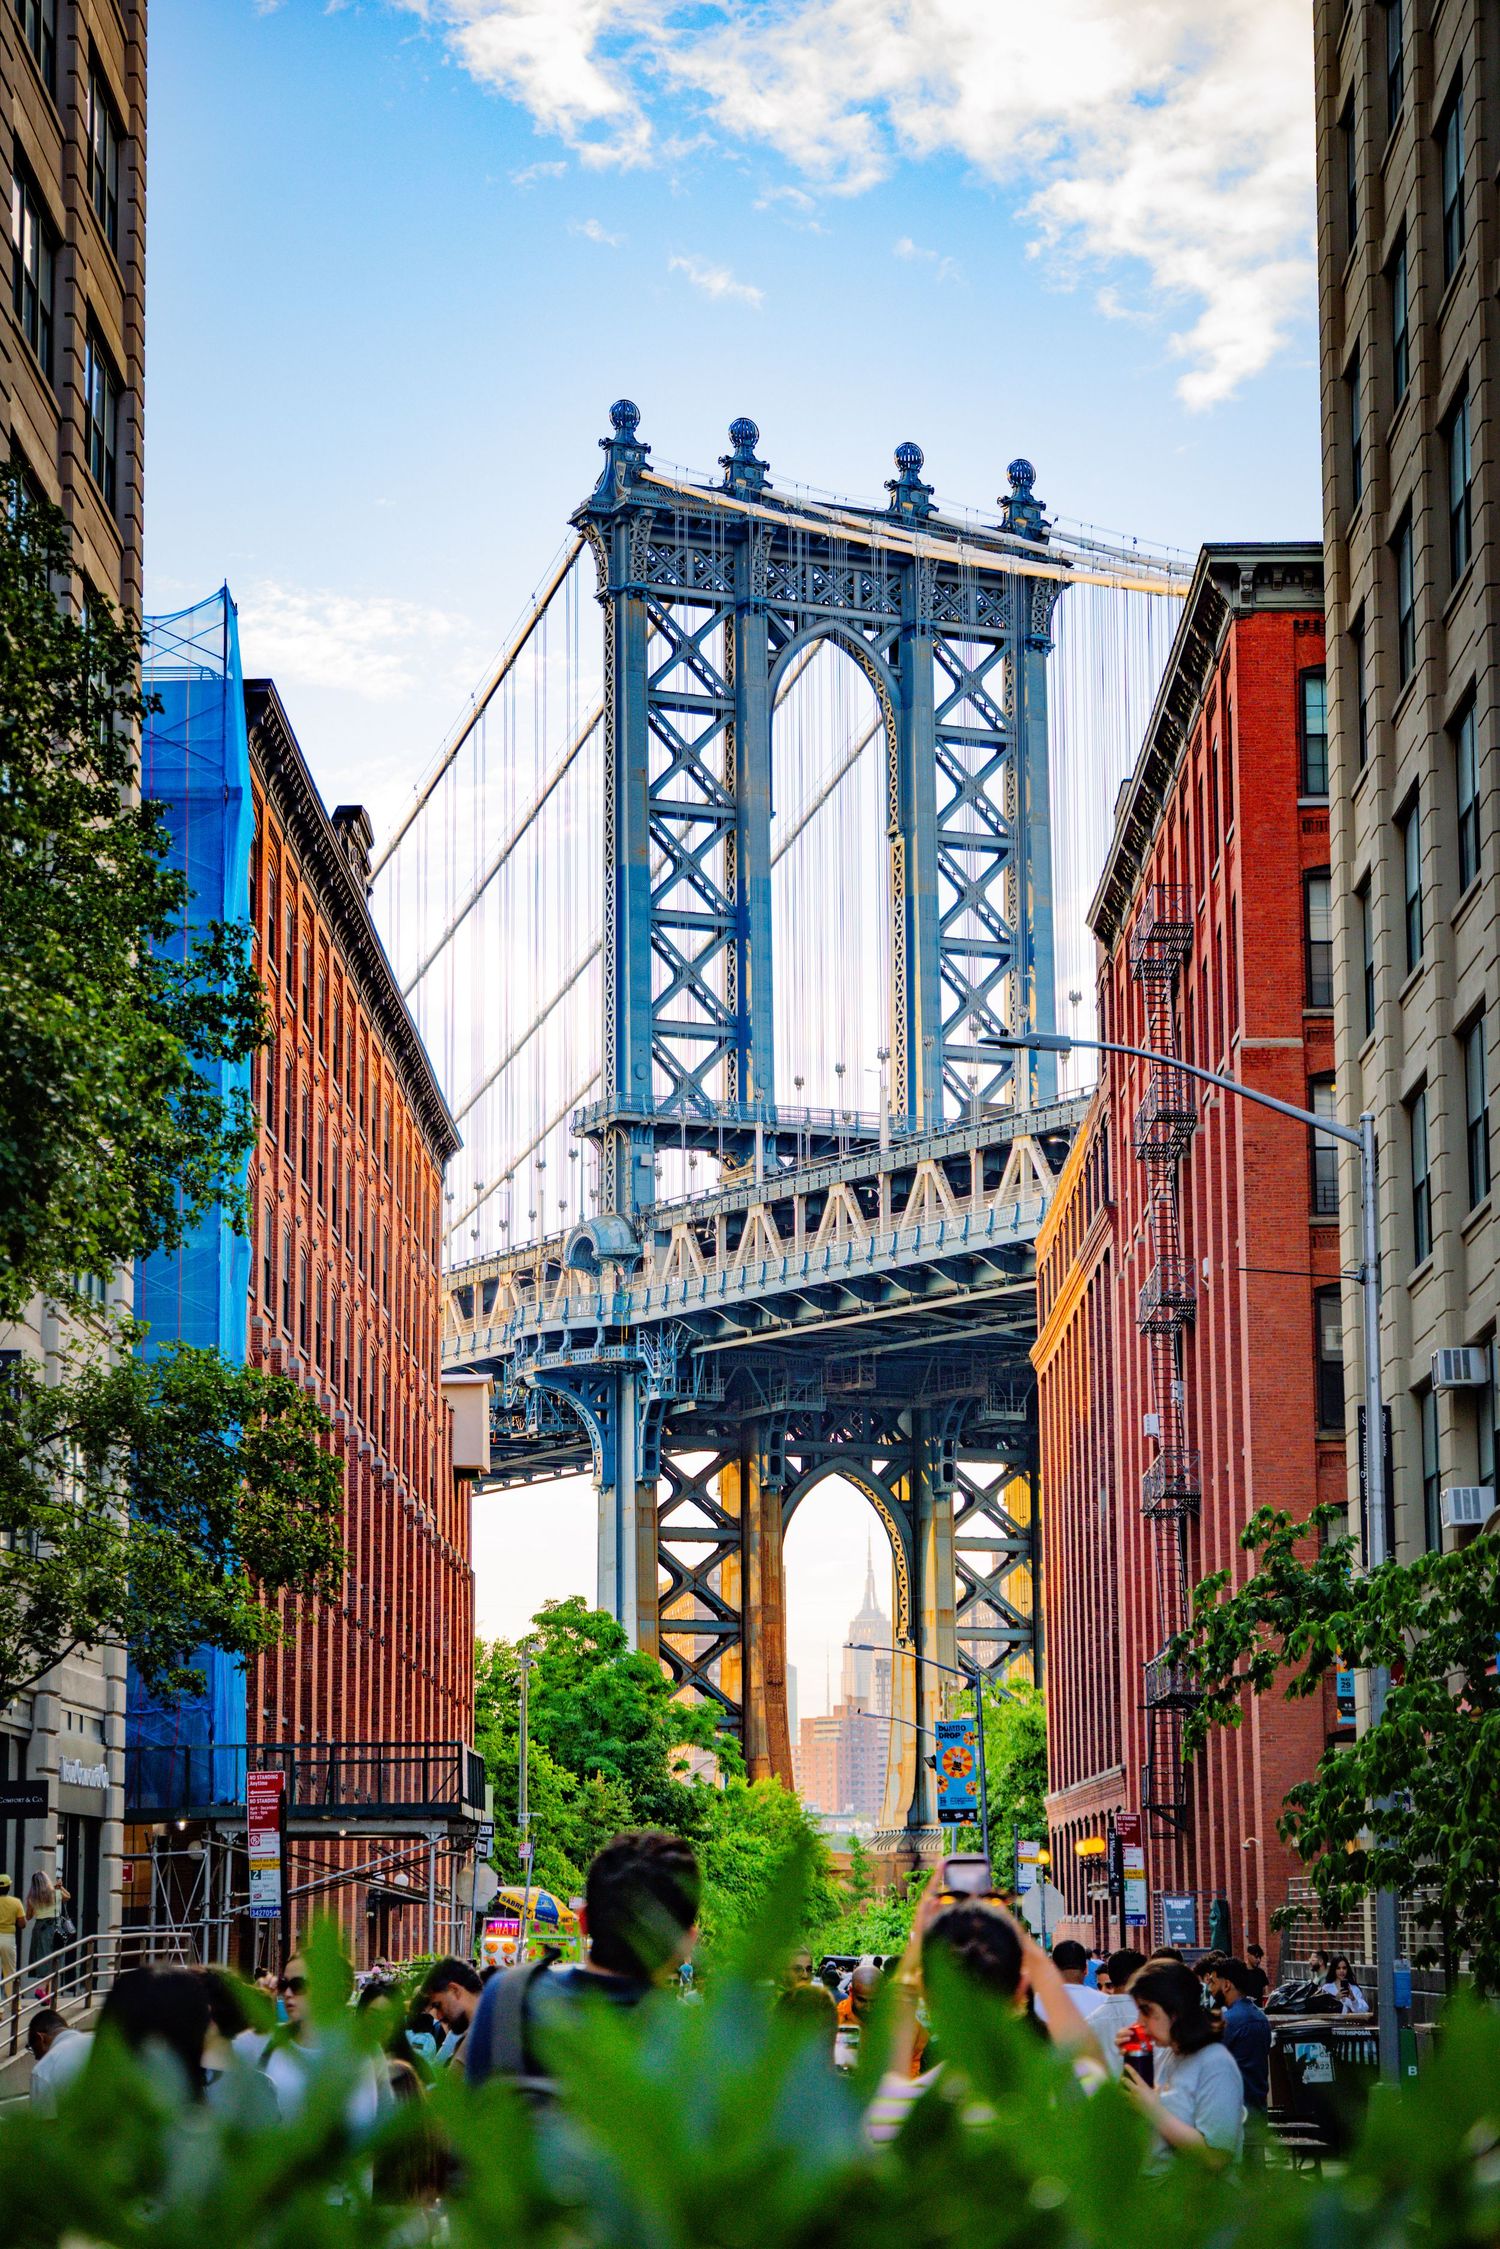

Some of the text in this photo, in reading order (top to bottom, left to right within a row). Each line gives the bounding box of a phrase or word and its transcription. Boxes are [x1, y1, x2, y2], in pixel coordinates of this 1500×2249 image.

[938, 1724, 966, 1732] DUMBO
[252, 1870, 259, 1880] 2
[502, 1895, 532, 1915] SABRET
[1408, 2065, 1417, 2076] B
